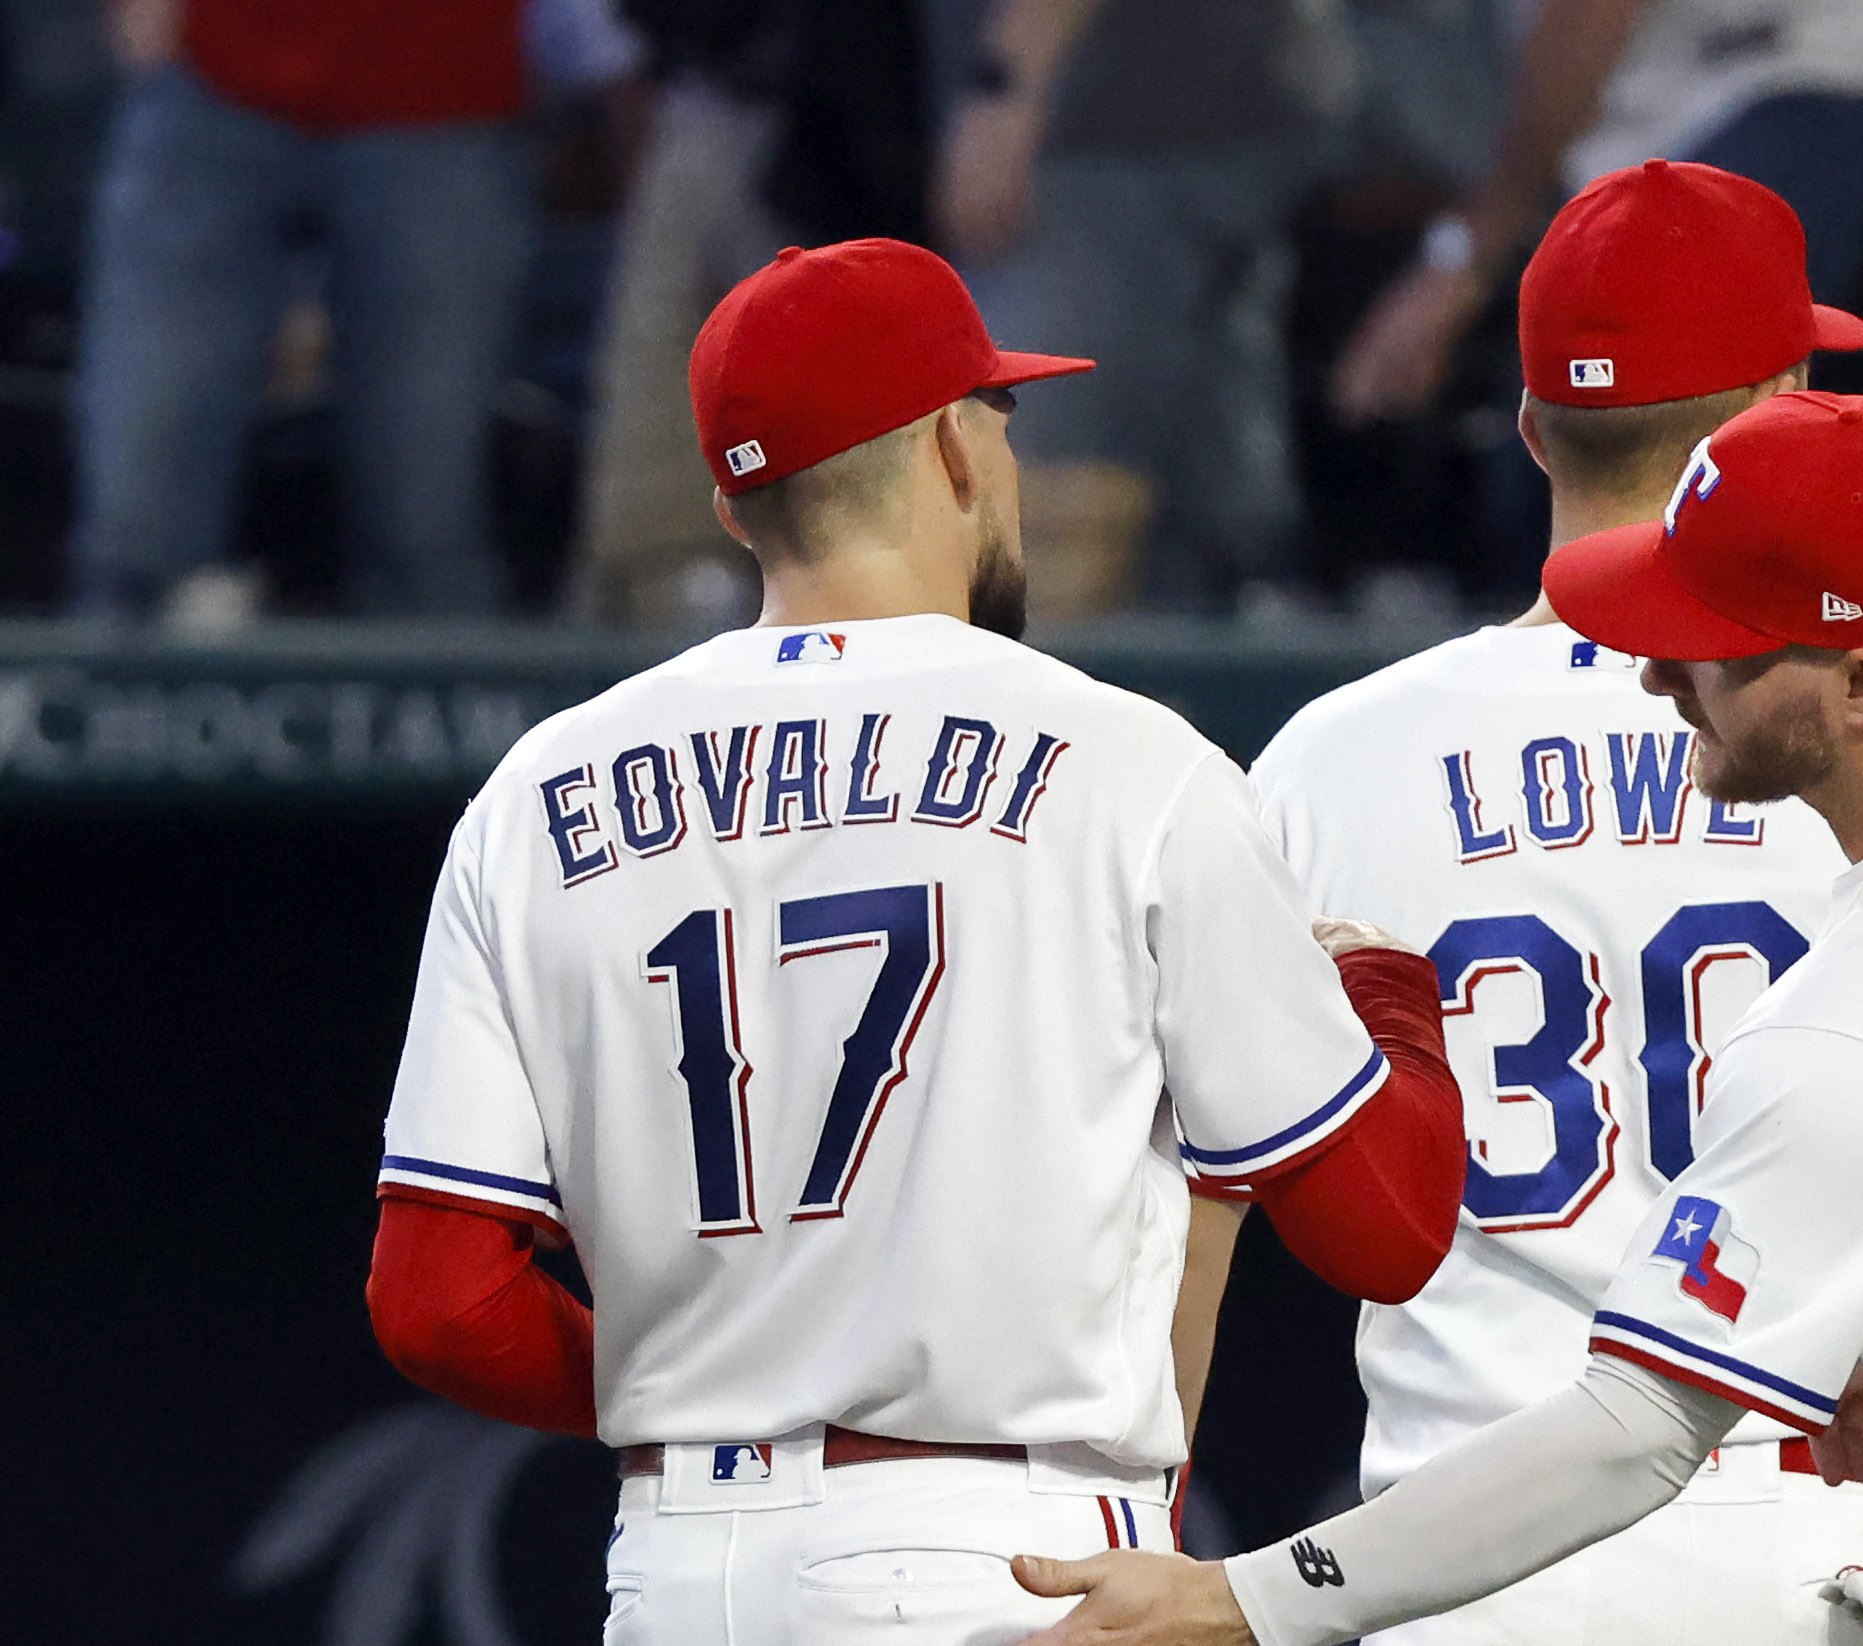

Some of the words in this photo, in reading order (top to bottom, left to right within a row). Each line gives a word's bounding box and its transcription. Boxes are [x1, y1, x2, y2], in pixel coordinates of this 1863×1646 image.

[534, 712, 1072, 890] EOVALDI
[638, 880, 946, 1238] 17
[1424, 898, 1812, 1234] 30
